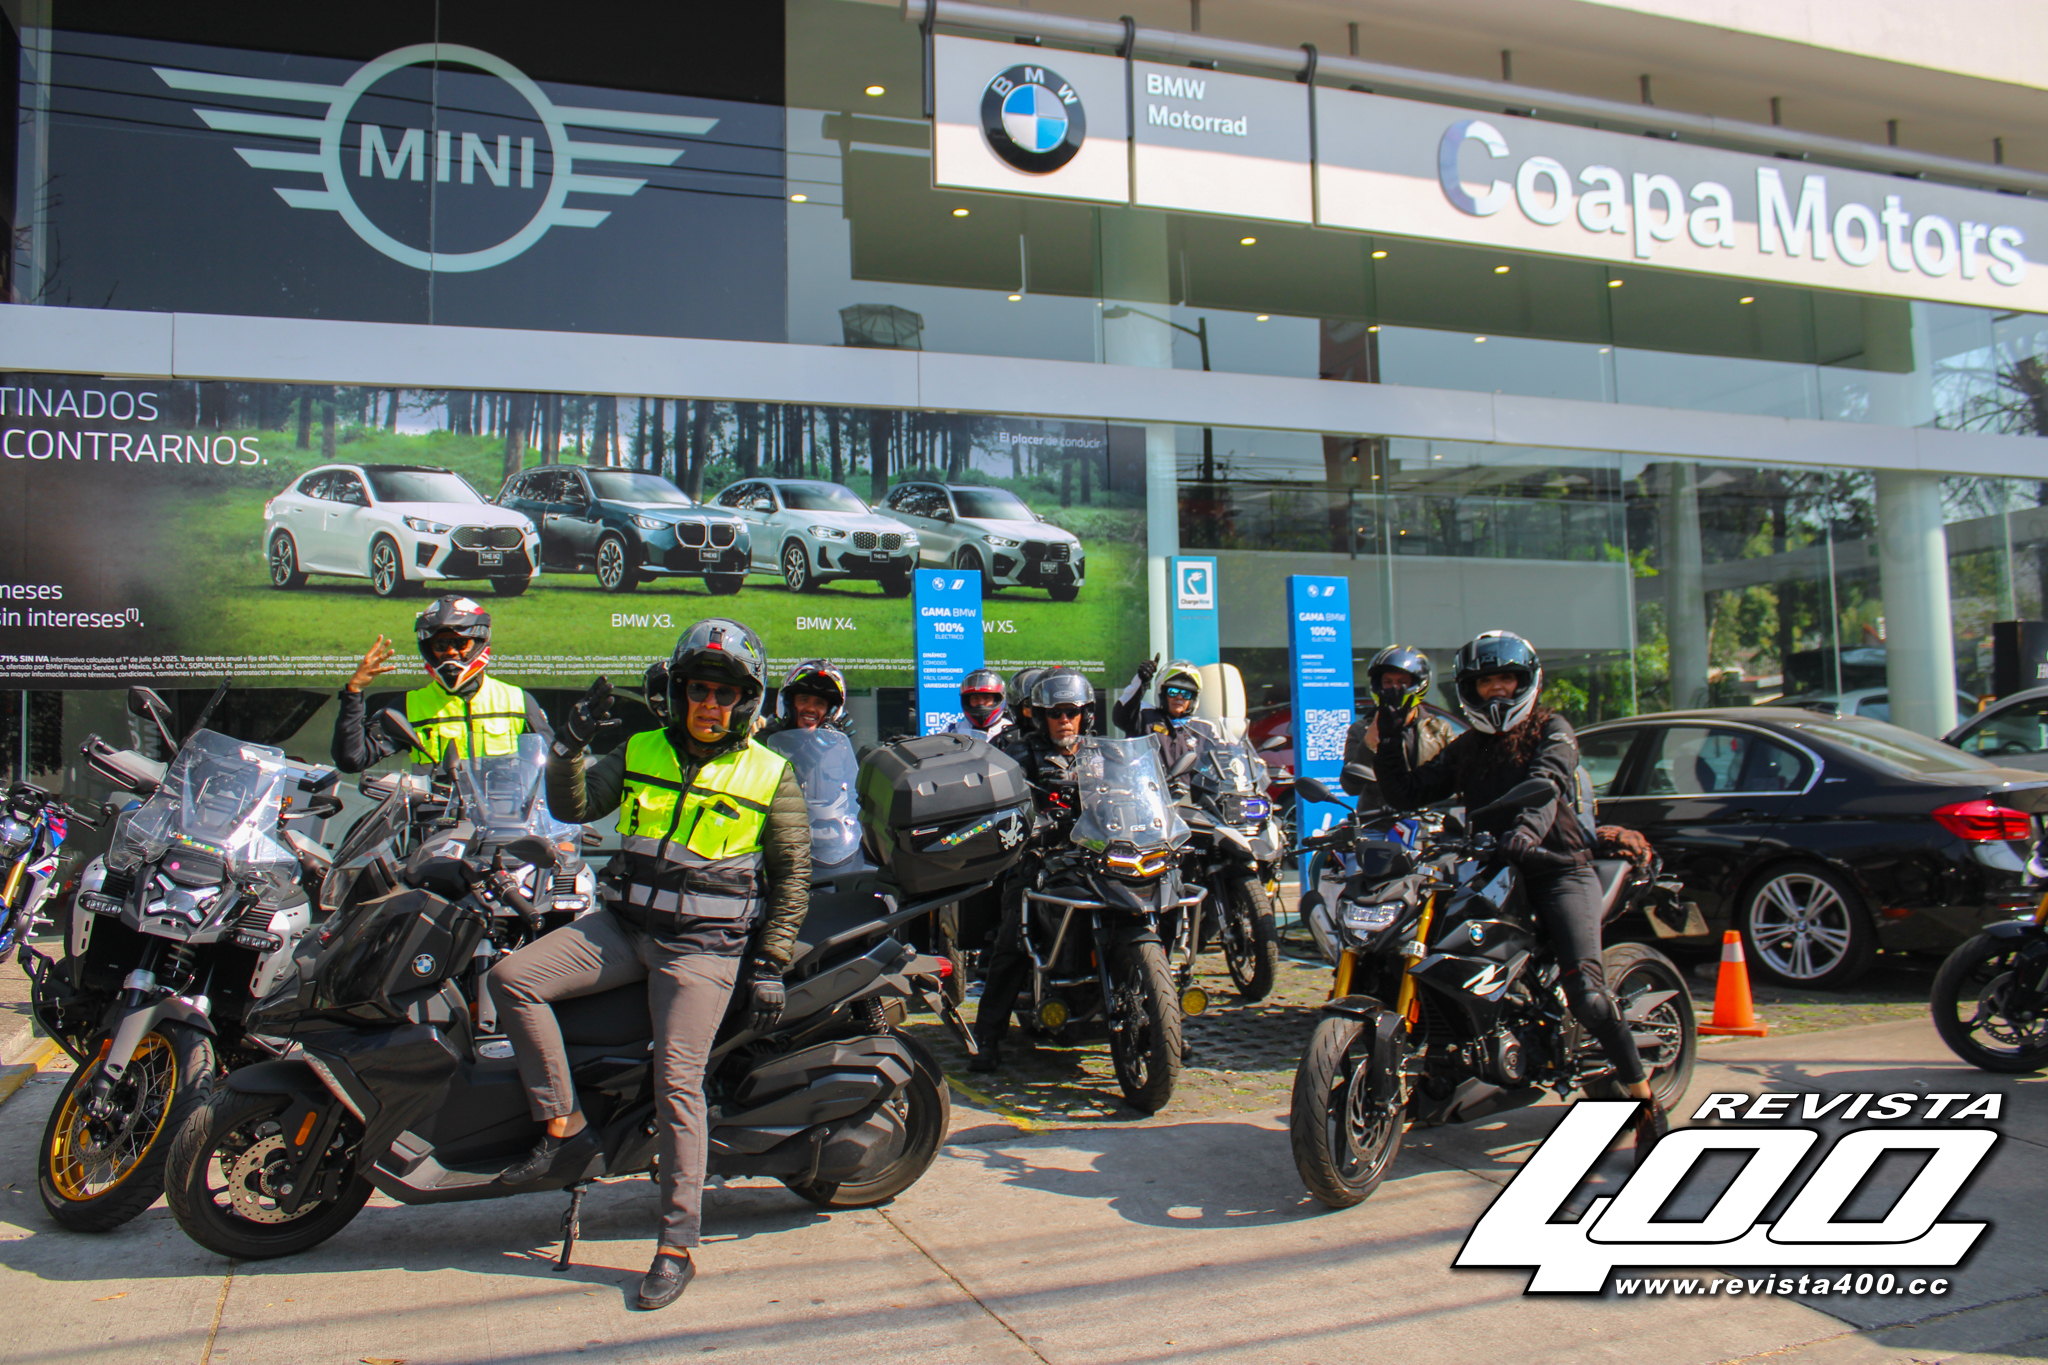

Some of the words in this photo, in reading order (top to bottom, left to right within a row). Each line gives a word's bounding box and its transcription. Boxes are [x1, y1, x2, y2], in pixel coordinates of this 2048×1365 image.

[991, 66, 1077, 106] BMW
[1147, 73, 1206, 100] BMW
[1148, 104, 1247, 137] Motorrad
[359, 124, 535, 189] MINI
[1438, 119, 1735, 259] Coapa
[1756, 166, 2027, 286] Motors
[0, 386, 159, 421] TINADOS
[3, 428, 268, 466] CONTRARNOS.
[999, 432, 1009, 443] El
[1012, 433, 1044, 446] placer
[1045, 435, 1058, 446] de
[1060, 437, 1101, 448] conducir
[0, 607, 21, 627] in
[921, 606, 951, 617] GAMA
[952, 607, 977, 617] BMW
[1299, 612, 1325, 621] GAMA
[611, 613, 650, 628] BMW
[653, 613, 675, 628] X3.
[796, 616, 832, 631] BMW
[834, 617, 857, 631] X4.
[933, 622, 965, 633] 100%
[997, 620, 1018, 634] X5.
[1310, 626, 1337, 636] 100%
[1129, 824, 1146, 832] GS
